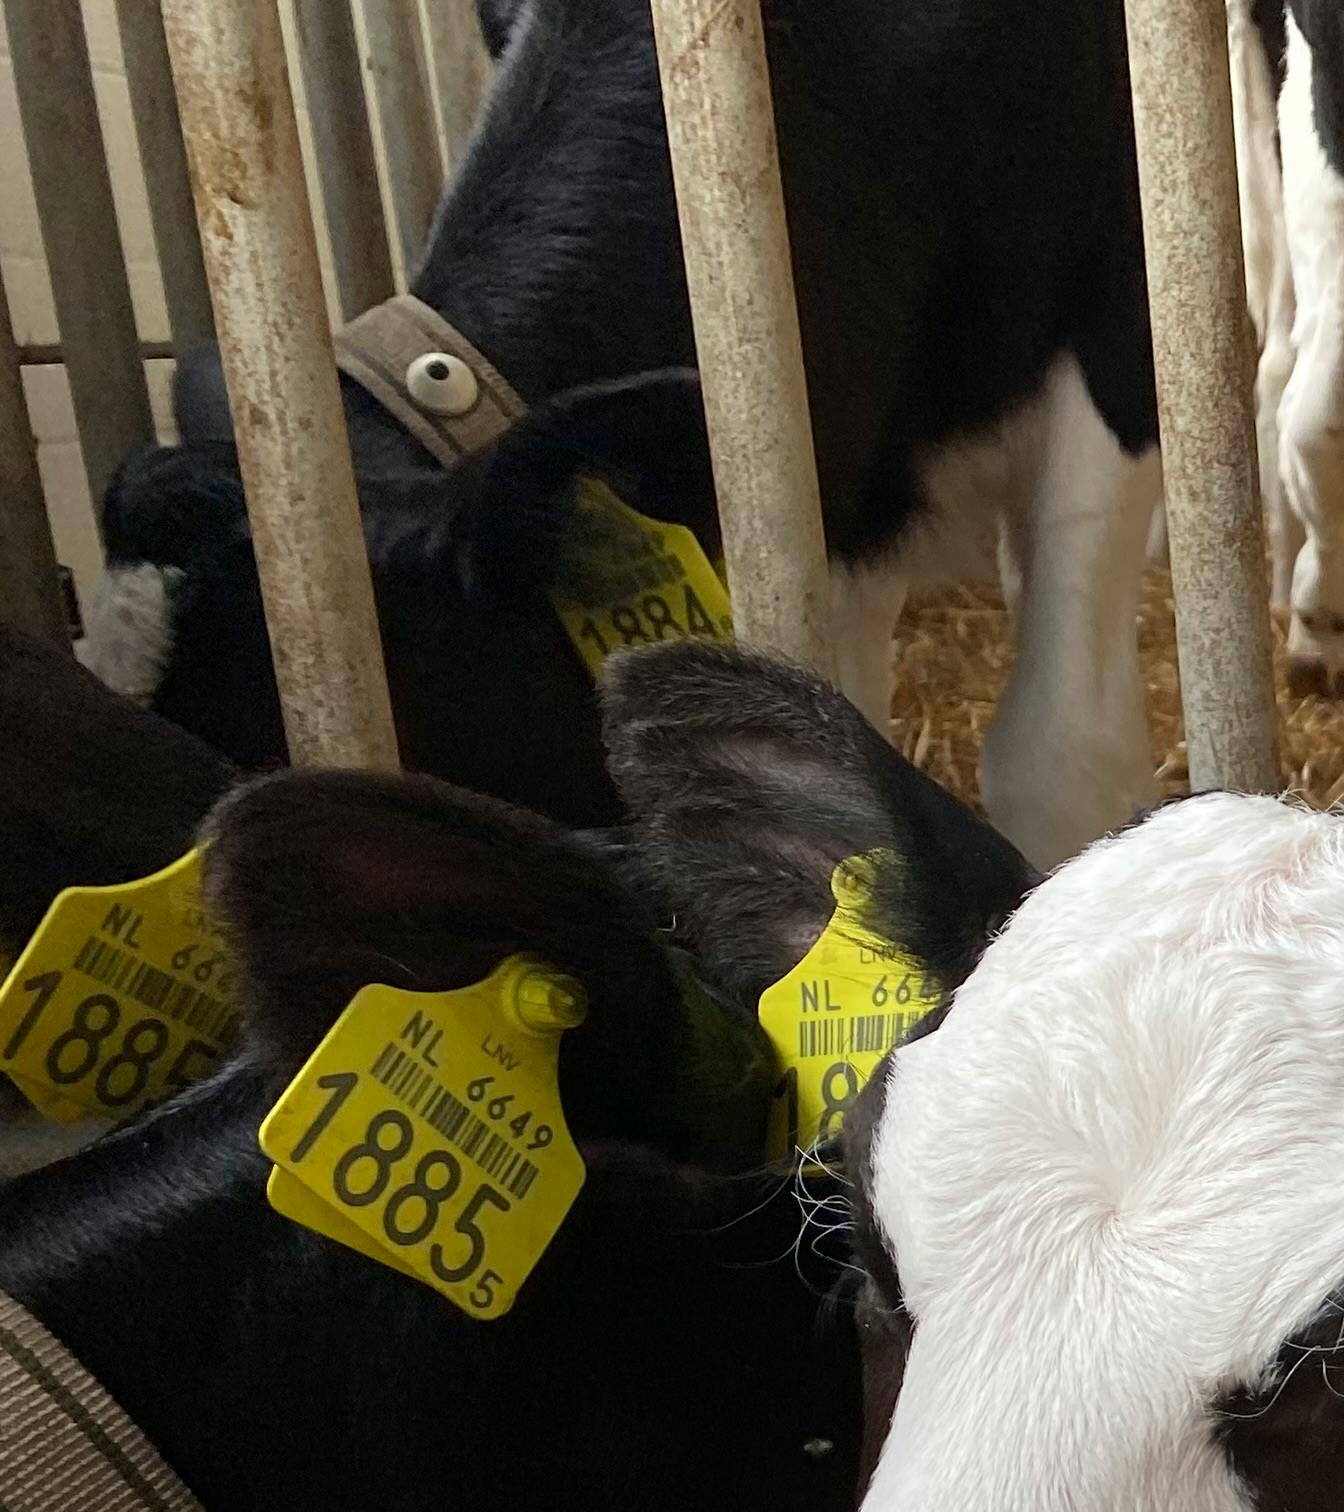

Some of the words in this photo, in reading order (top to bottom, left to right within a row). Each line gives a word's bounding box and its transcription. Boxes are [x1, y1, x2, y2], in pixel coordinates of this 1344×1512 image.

[101, 903, 144, 949] NL
[800, 978, 841, 1014] NL
[479, 1036, 521, 1072] LNV
[400, 1009, 444, 1068] NL
[466, 1075, 554, 1152] 6649
[289, 1071, 512, 1284] 1885
